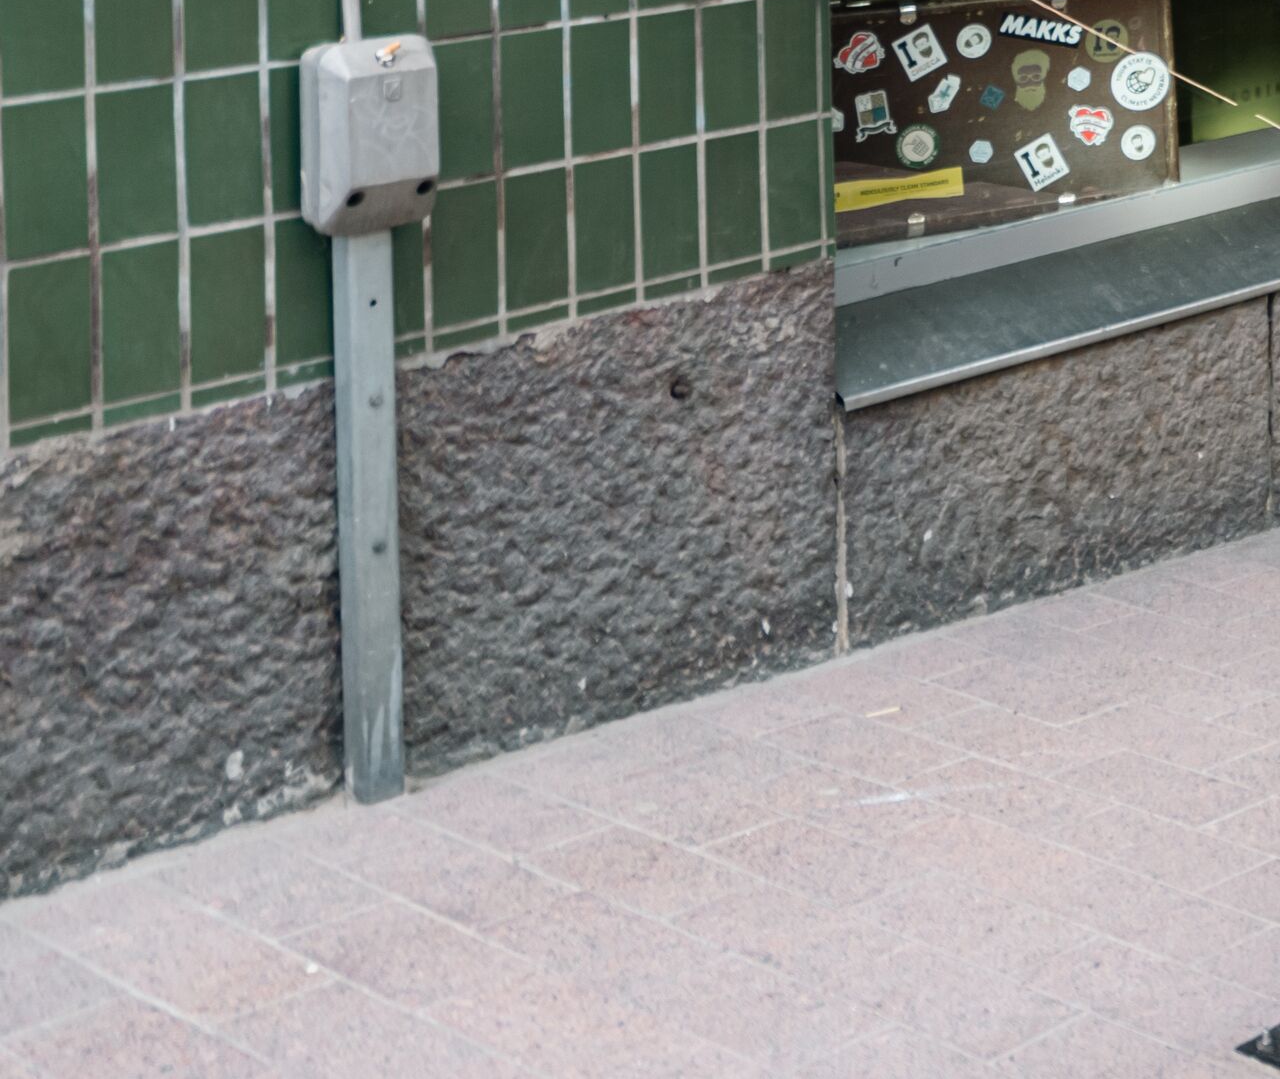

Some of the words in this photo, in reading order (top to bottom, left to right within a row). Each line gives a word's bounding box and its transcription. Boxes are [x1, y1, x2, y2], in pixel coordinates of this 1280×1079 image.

[1000, 14, 1083, 46] MAKKS
[1128, 57, 1144, 67] STAY
[1120, 94, 1147, 106] CLIMATE
[1034, 166, 1064, 187] Helsinki
